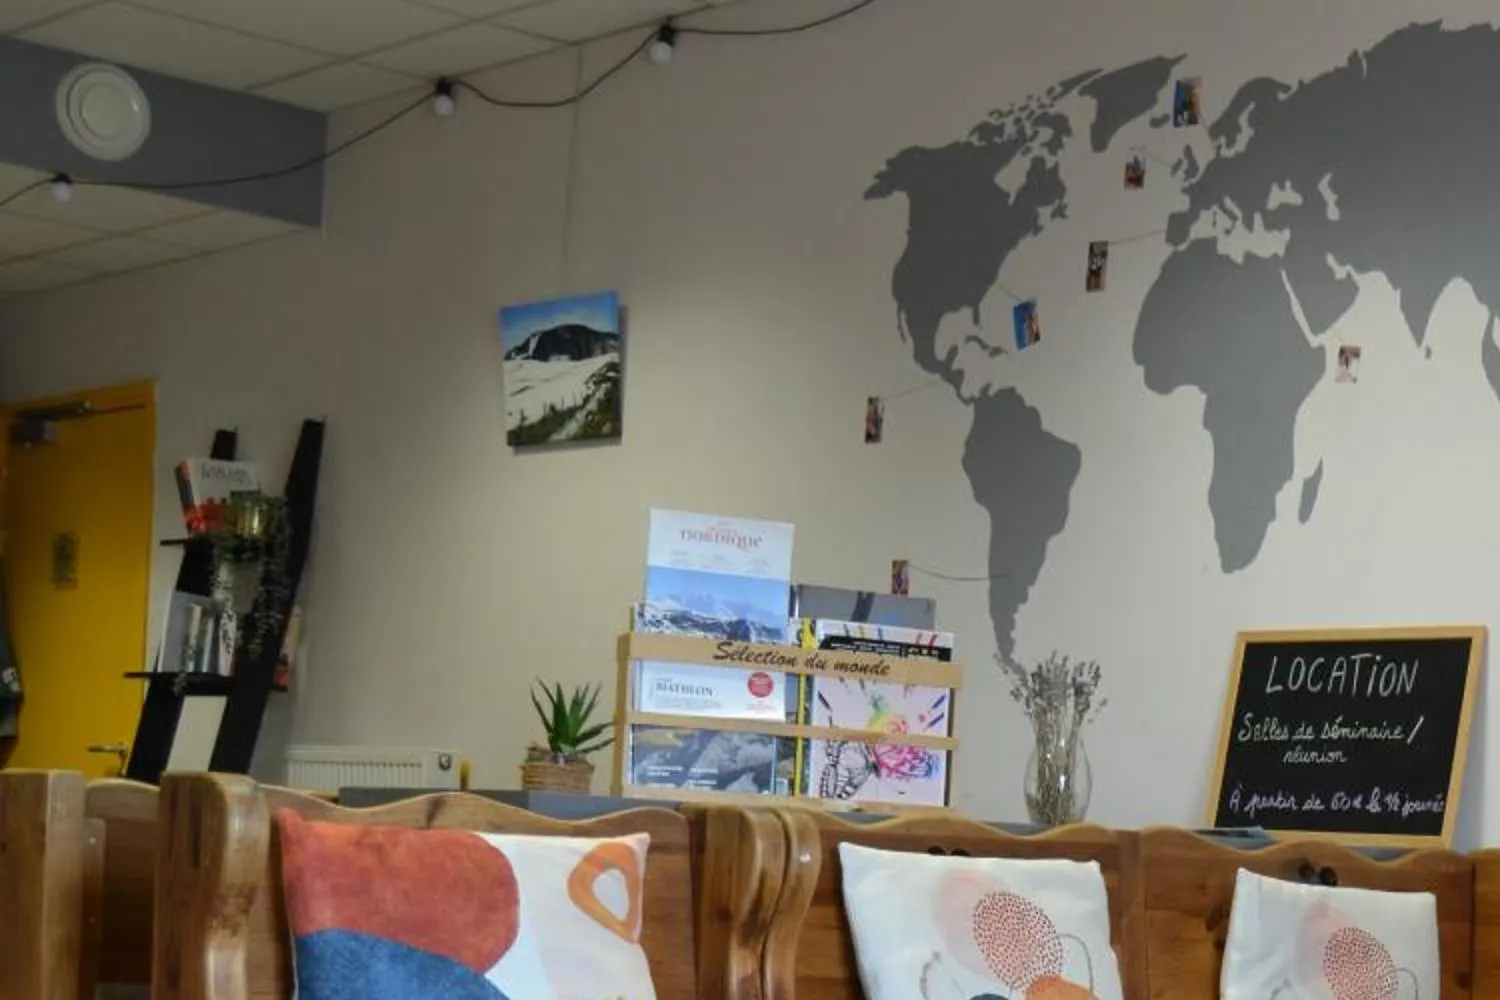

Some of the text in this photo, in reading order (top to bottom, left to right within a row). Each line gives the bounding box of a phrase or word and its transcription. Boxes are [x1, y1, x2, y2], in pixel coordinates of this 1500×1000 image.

[804, 653, 826, 670] du
[834, 658, 891, 677] monde
[1238, 712, 1289, 741] Salles
[1291, 720, 1315, 740] de
[1244, 789, 1298, 819] partir
[1302, 792, 1326, 812] de
